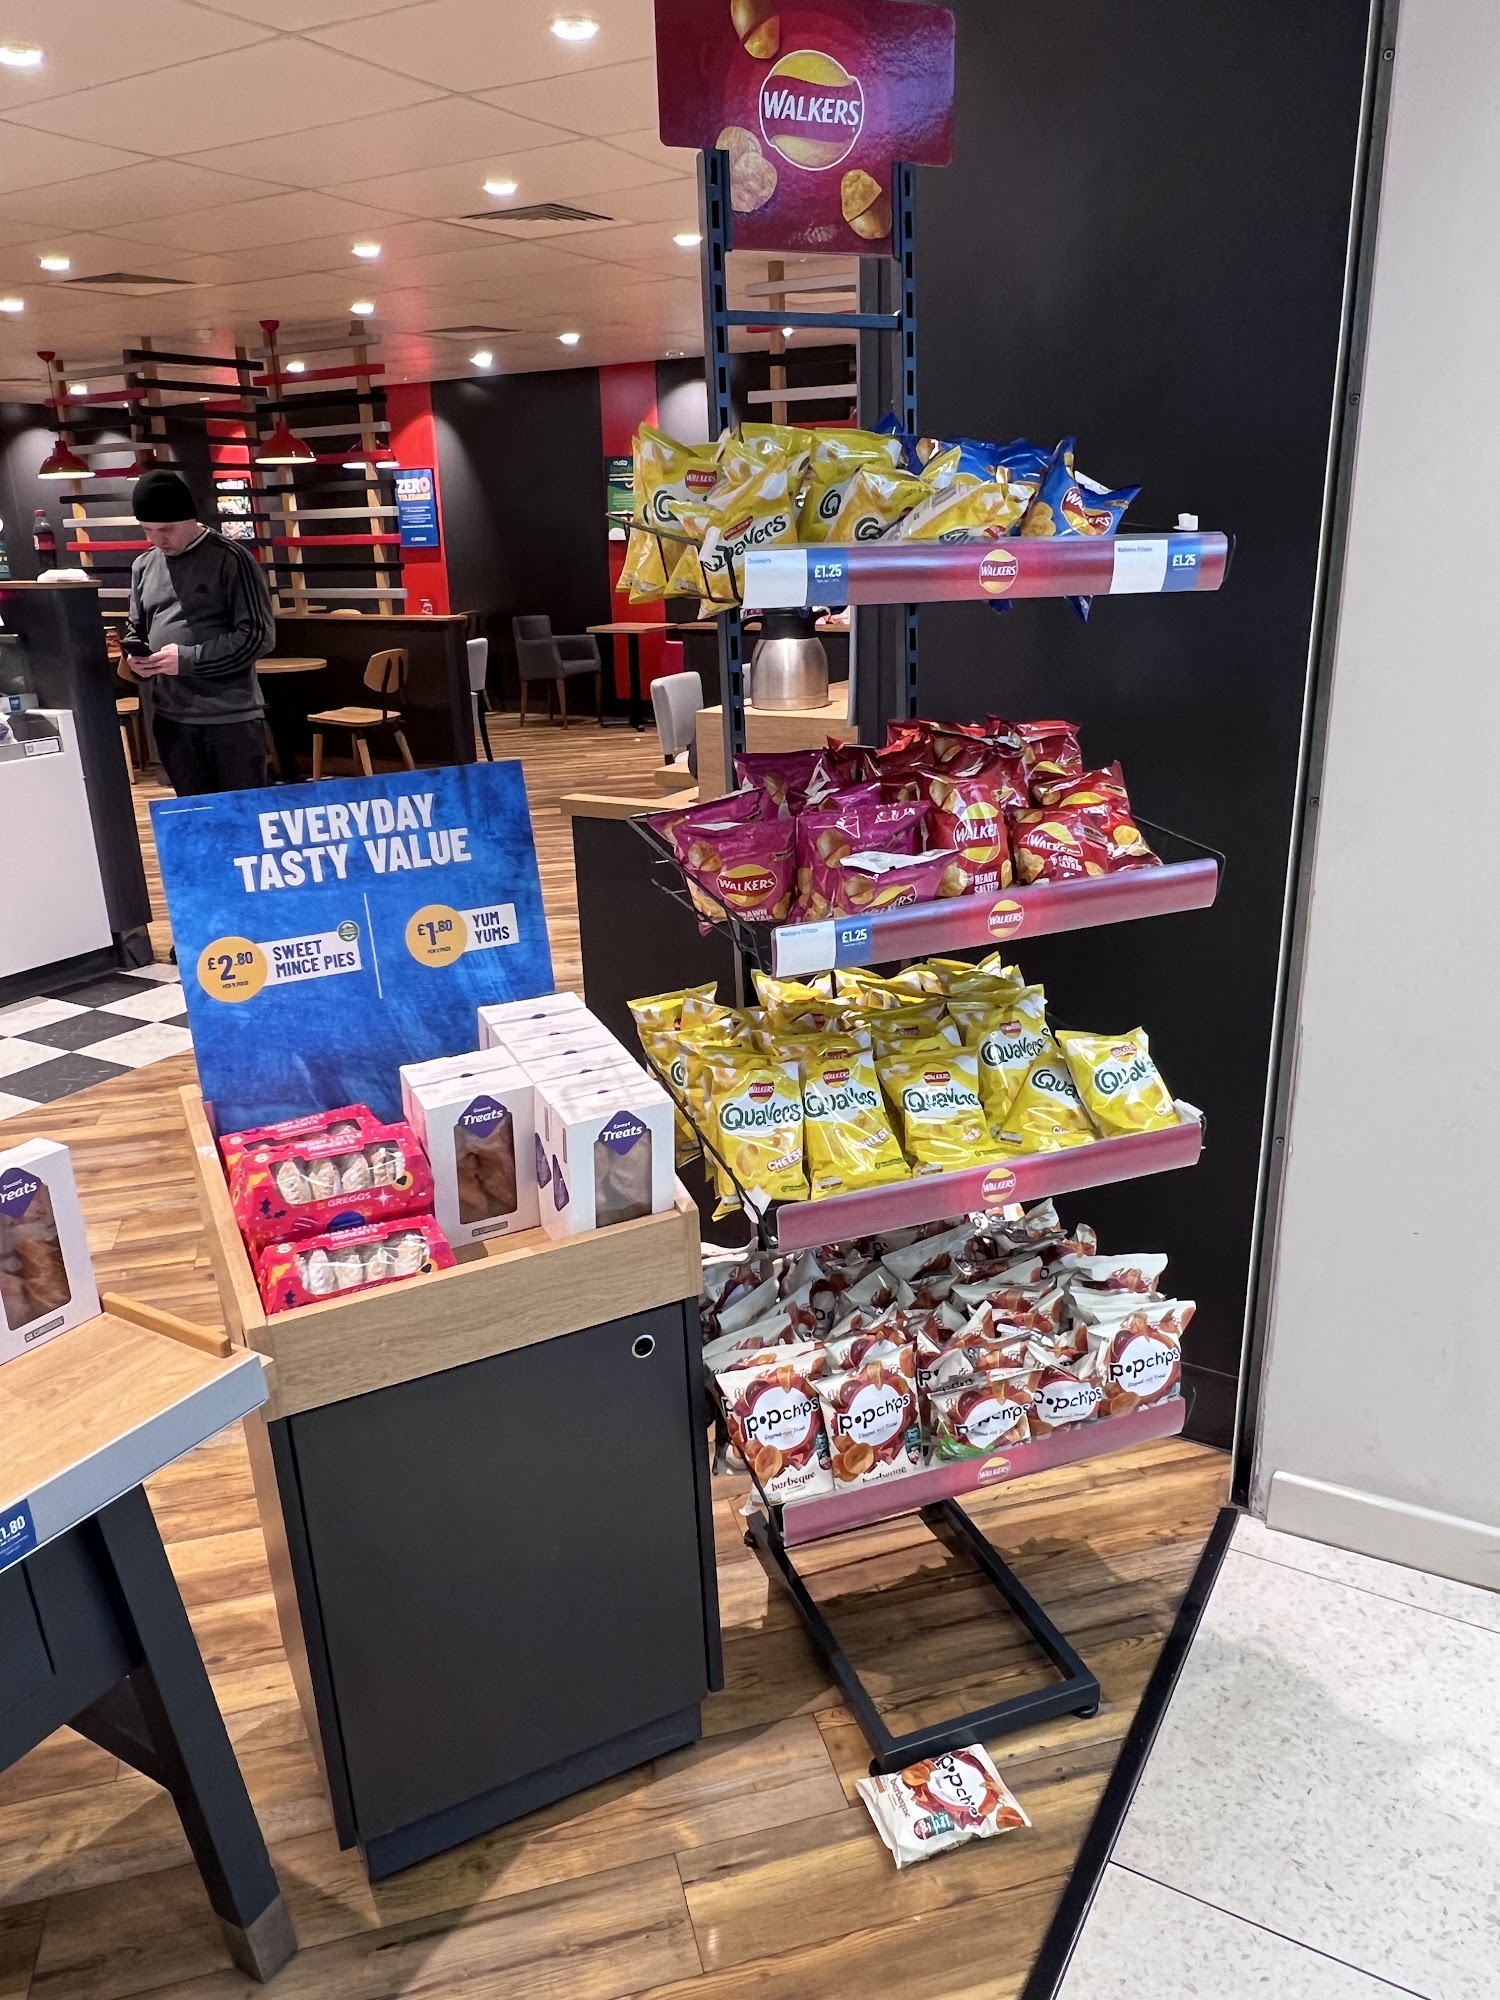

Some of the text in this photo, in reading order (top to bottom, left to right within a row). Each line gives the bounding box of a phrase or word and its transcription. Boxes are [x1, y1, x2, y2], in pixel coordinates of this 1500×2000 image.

[763, 89, 861, 127] WALKERS
[396, 477, 431, 494] ZERO
[1172, 553, 1196, 567] £1.25
[814, 564, 842, 578] £1.25
[980, 562, 1017, 577] WALKERS
[258, 793, 435, 849] EVERYDAY
[233, 827, 472, 893] TASTY VALUE
[718, 877, 775, 892] WALKERS
[472, 911, 500, 928] YUM
[989, 912, 1022, 926] WALKERS
[417, 919, 453, 946] £1.80
[474, 926, 510, 944] YUMS
[842, 928, 868, 944] £1.25
[272, 940, 322, 961] SWEET
[207, 951, 253, 981] £2.80
[275, 951, 356, 978] MINCE PIES
[804, 1088, 877, 1118] Quavers
[463, 1109, 504, 1126] Treats
[720, 1102, 801, 1131] Quavers
[602, 1126, 643, 1142] Treats
[983, 1178, 1015, 1192] WALKERS
[327, 1191, 372, 1208] GREGGS
[771, 1471, 816, 1492] barbeque
[890, 1776, 911, 1819] barbeque
